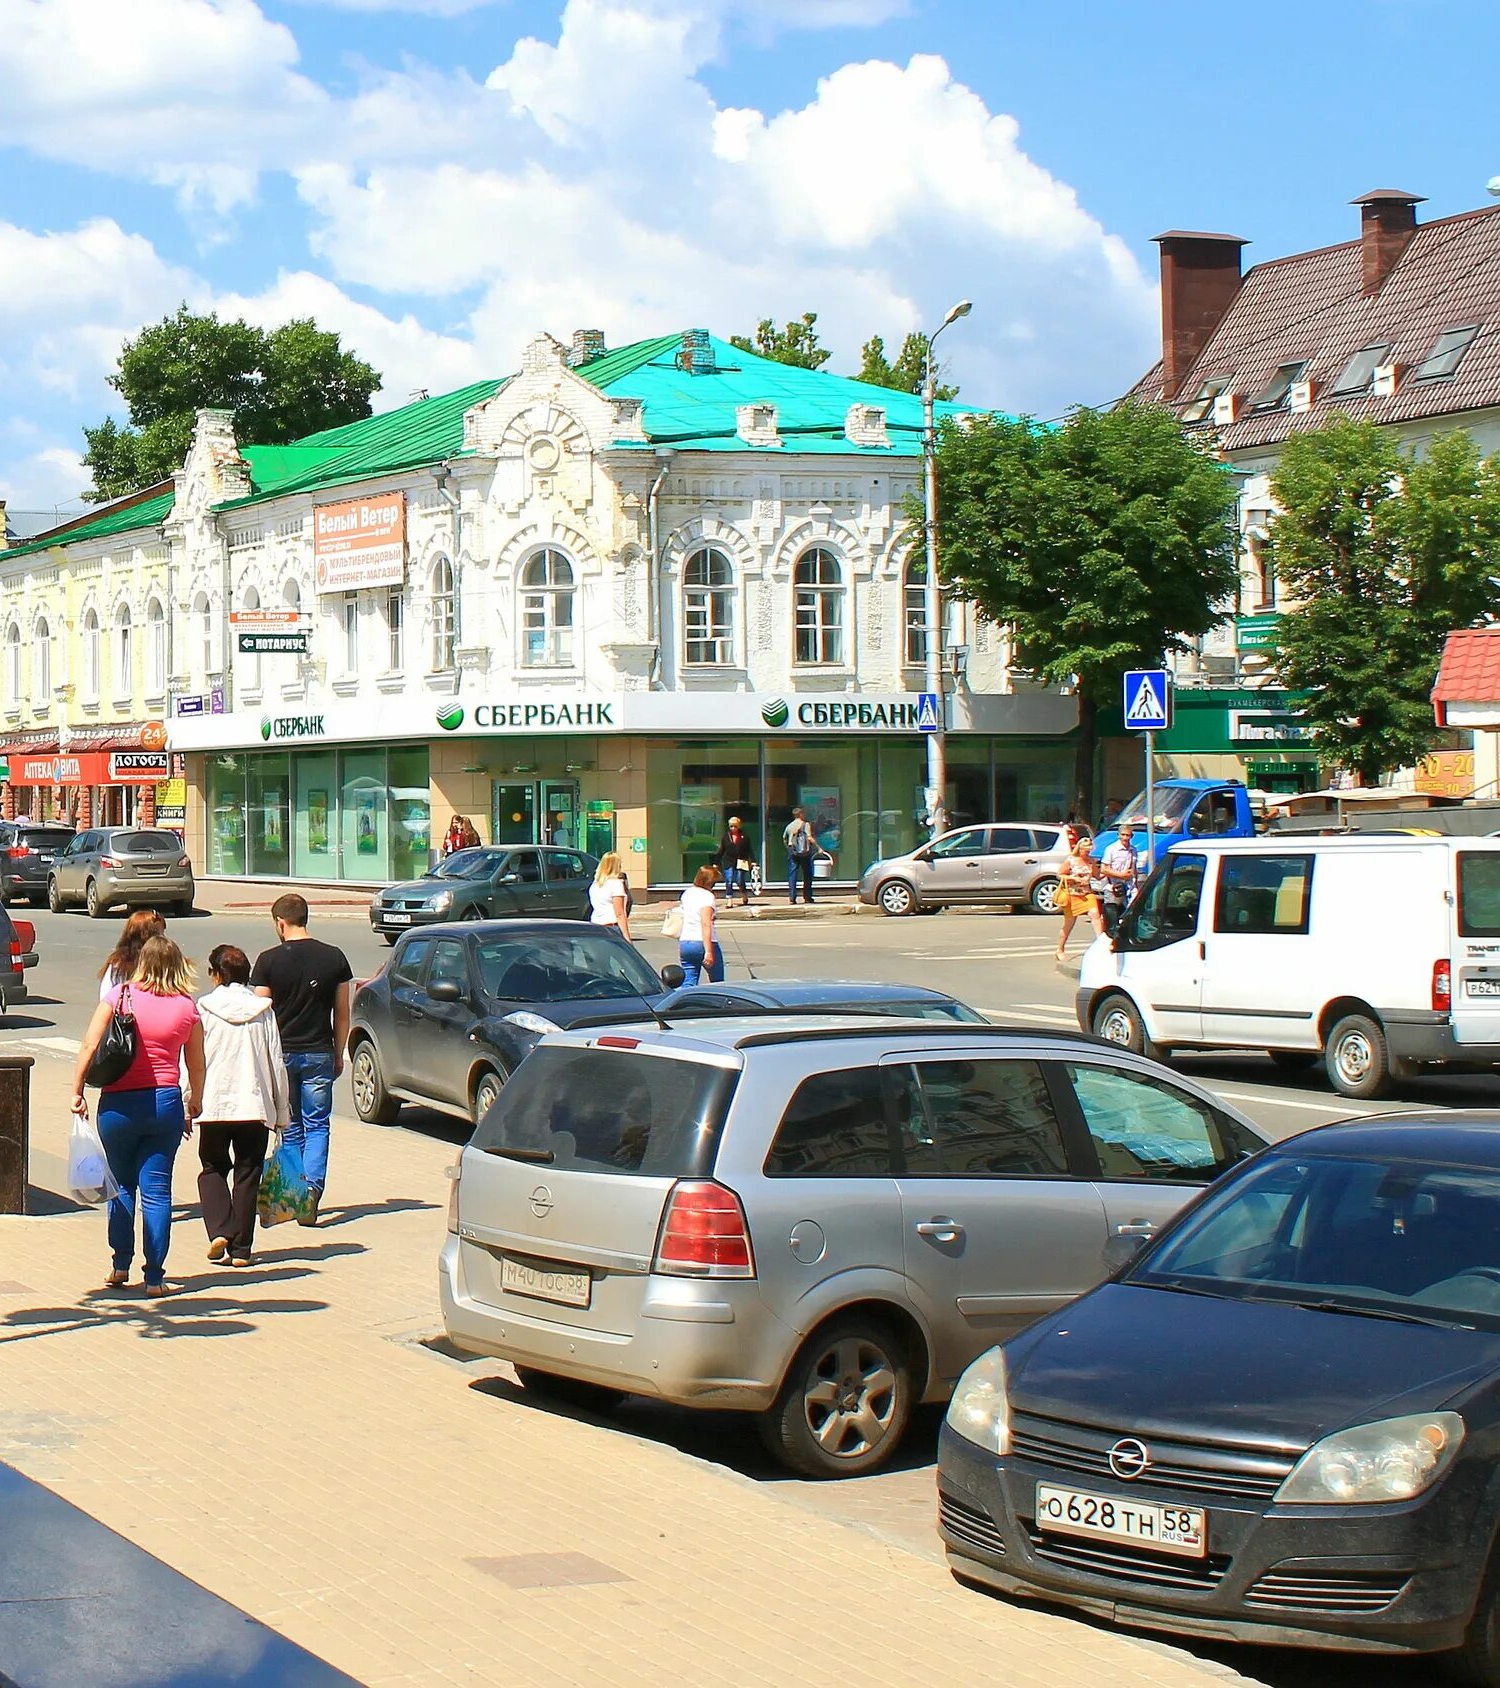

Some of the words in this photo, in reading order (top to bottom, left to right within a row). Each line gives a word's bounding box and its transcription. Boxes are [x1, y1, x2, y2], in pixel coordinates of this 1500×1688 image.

[318, 508, 358, 535] Белый
[360, 505, 398, 528] Ветер
[329, 547, 401, 569] МУЛЬТИБРЕНДОВЫЙ
[329, 566, 401, 585] ИНТЕРНЕТ-МАГАЗИН
[255, 638, 304, 650] НОТАРИУС
[474, 703, 614, 727] СБЕРБАНК
[143, 728, 160, 740] 24
[273, 715, 325, 738] СБЕРБАНК
[24, 762, 53, 779] АПТЕКА
[60, 759, 81, 775] ВИТА
[115, 755, 166, 767] ЛОГОСЪ
[157, 810, 184, 818] КНИГИ
[1048, 1495, 1154, 1537] О628ТН
[1163, 1509, 1192, 1533] 58
[1161, 1530, 1183, 1543] RUS
